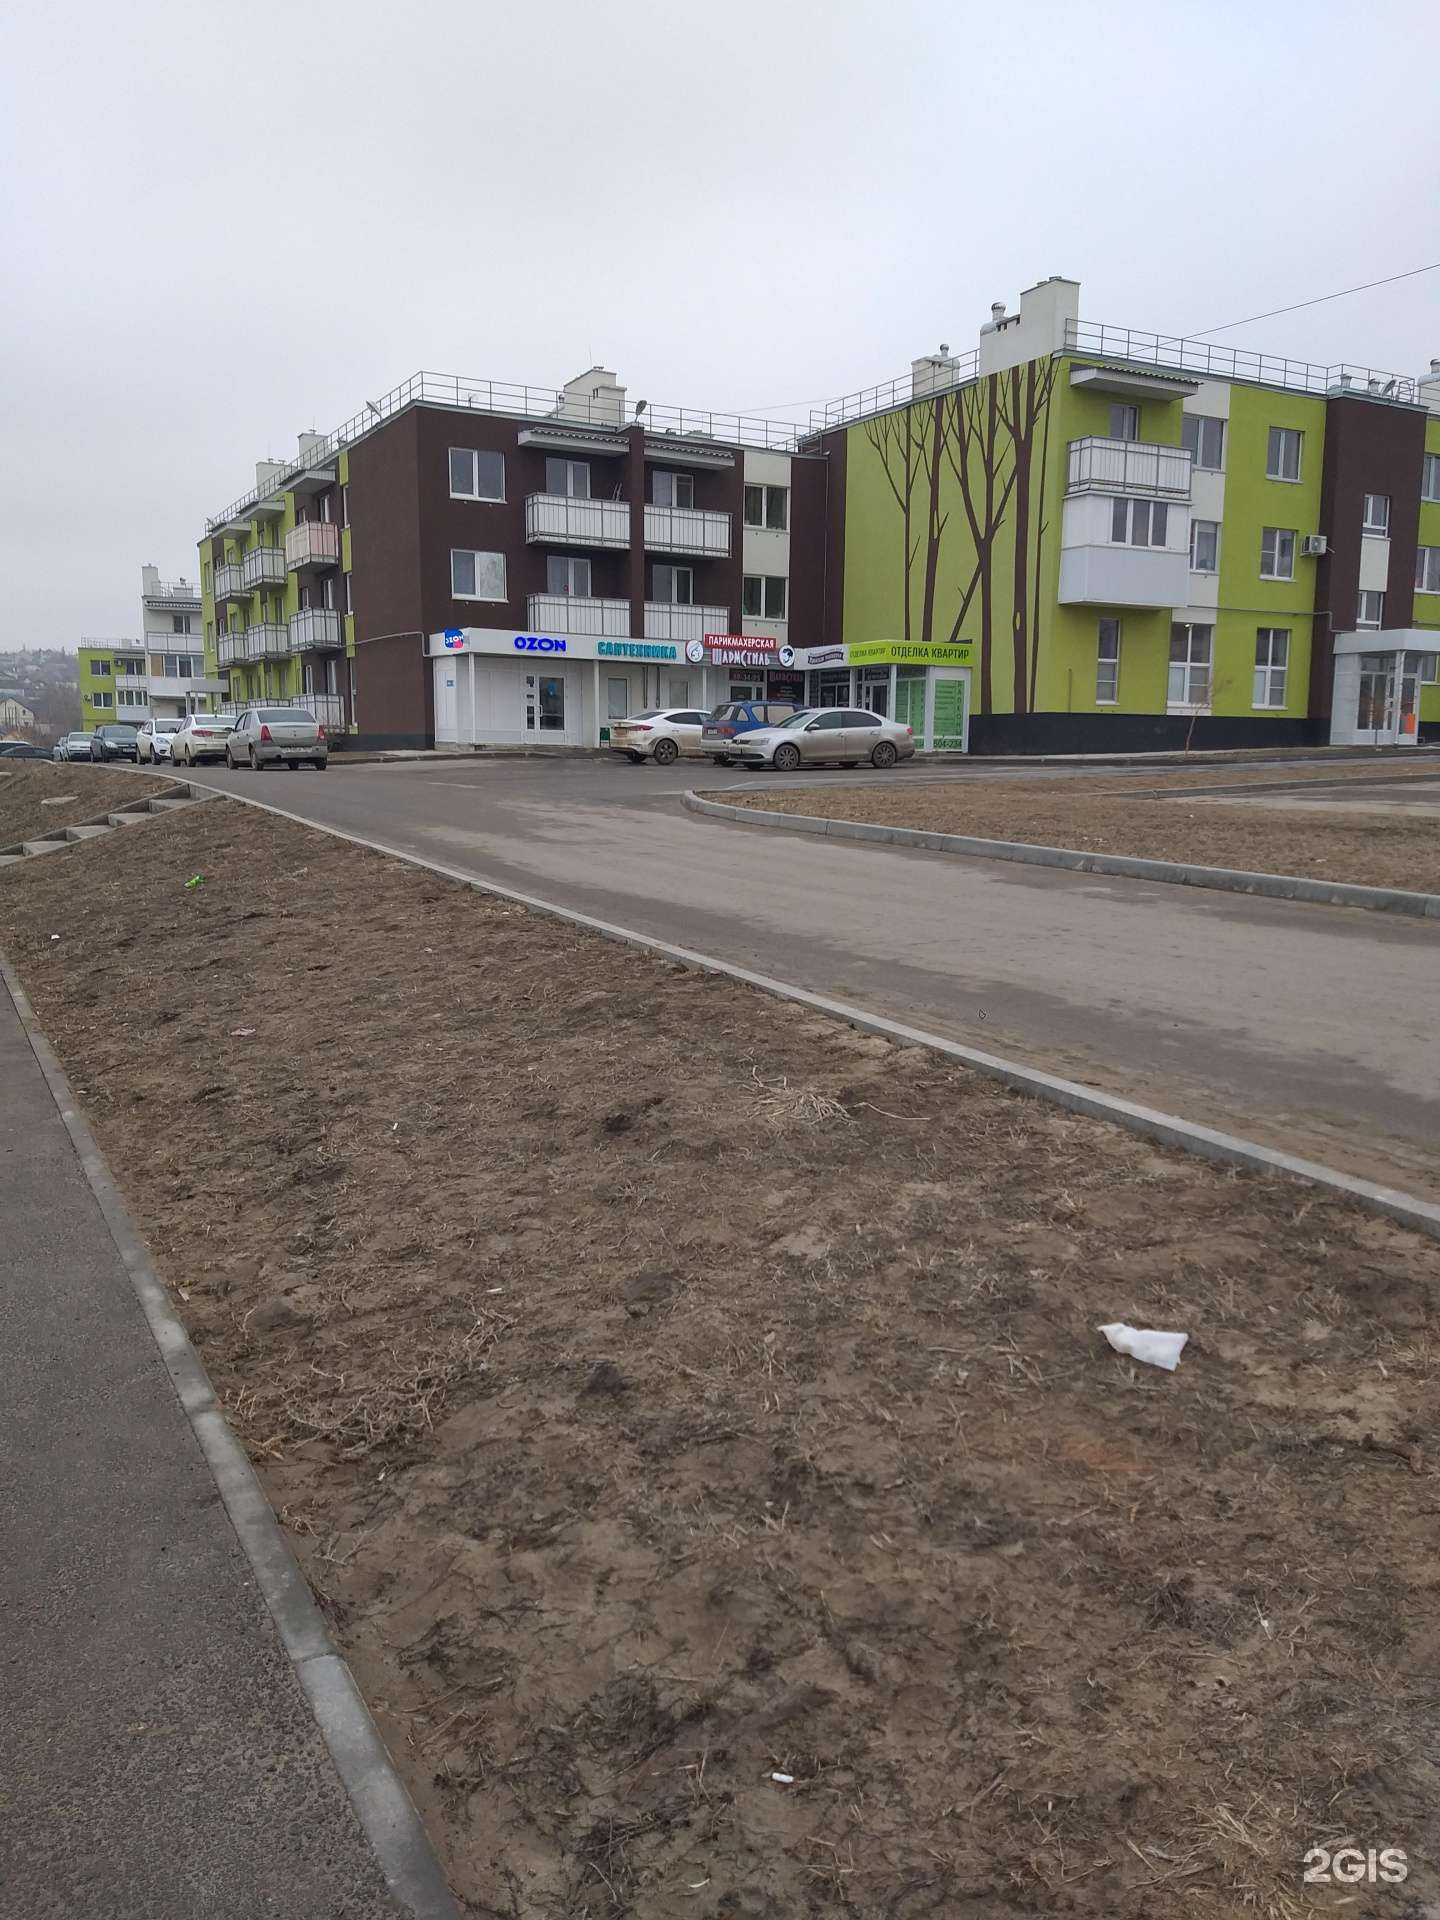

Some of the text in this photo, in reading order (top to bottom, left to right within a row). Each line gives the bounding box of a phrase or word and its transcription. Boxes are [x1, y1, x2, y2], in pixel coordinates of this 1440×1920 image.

[514, 636, 567, 652] OZON
[708, 635, 774, 649] ПАРИКМАХЕРСКАЯ
[597, 641, 677, 659] САНТЕХНИКА
[891, 646, 969, 659] ОТДЕЛКА КВАРТИР
